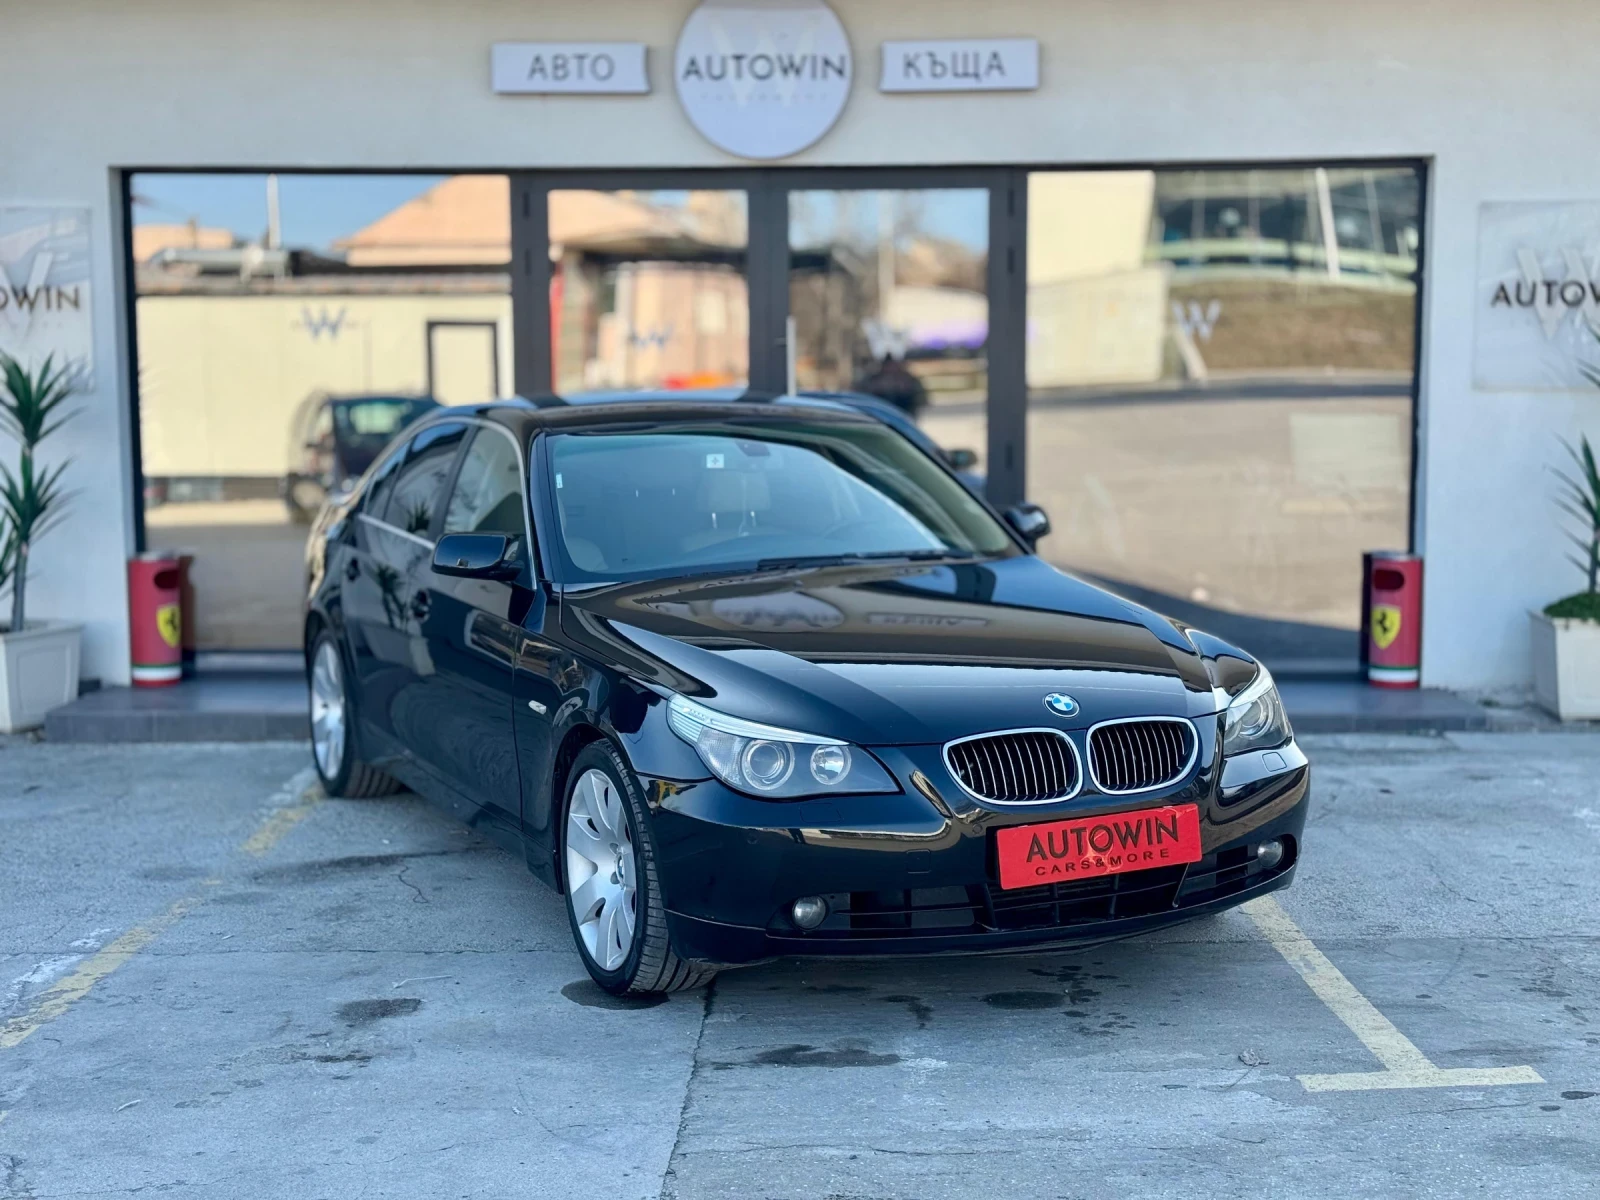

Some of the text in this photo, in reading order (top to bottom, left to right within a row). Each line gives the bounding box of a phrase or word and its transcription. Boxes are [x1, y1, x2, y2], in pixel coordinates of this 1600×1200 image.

[527, 53, 616, 82] АВТО
[682, 53, 847, 81] AUTOWIN
[903, 50, 1007, 84] КЪЩА
[301, 303, 347, 344] W
[1026, 814, 1179, 863] AUTOWIN
[1035, 847, 1170, 877] CARS&MORE
